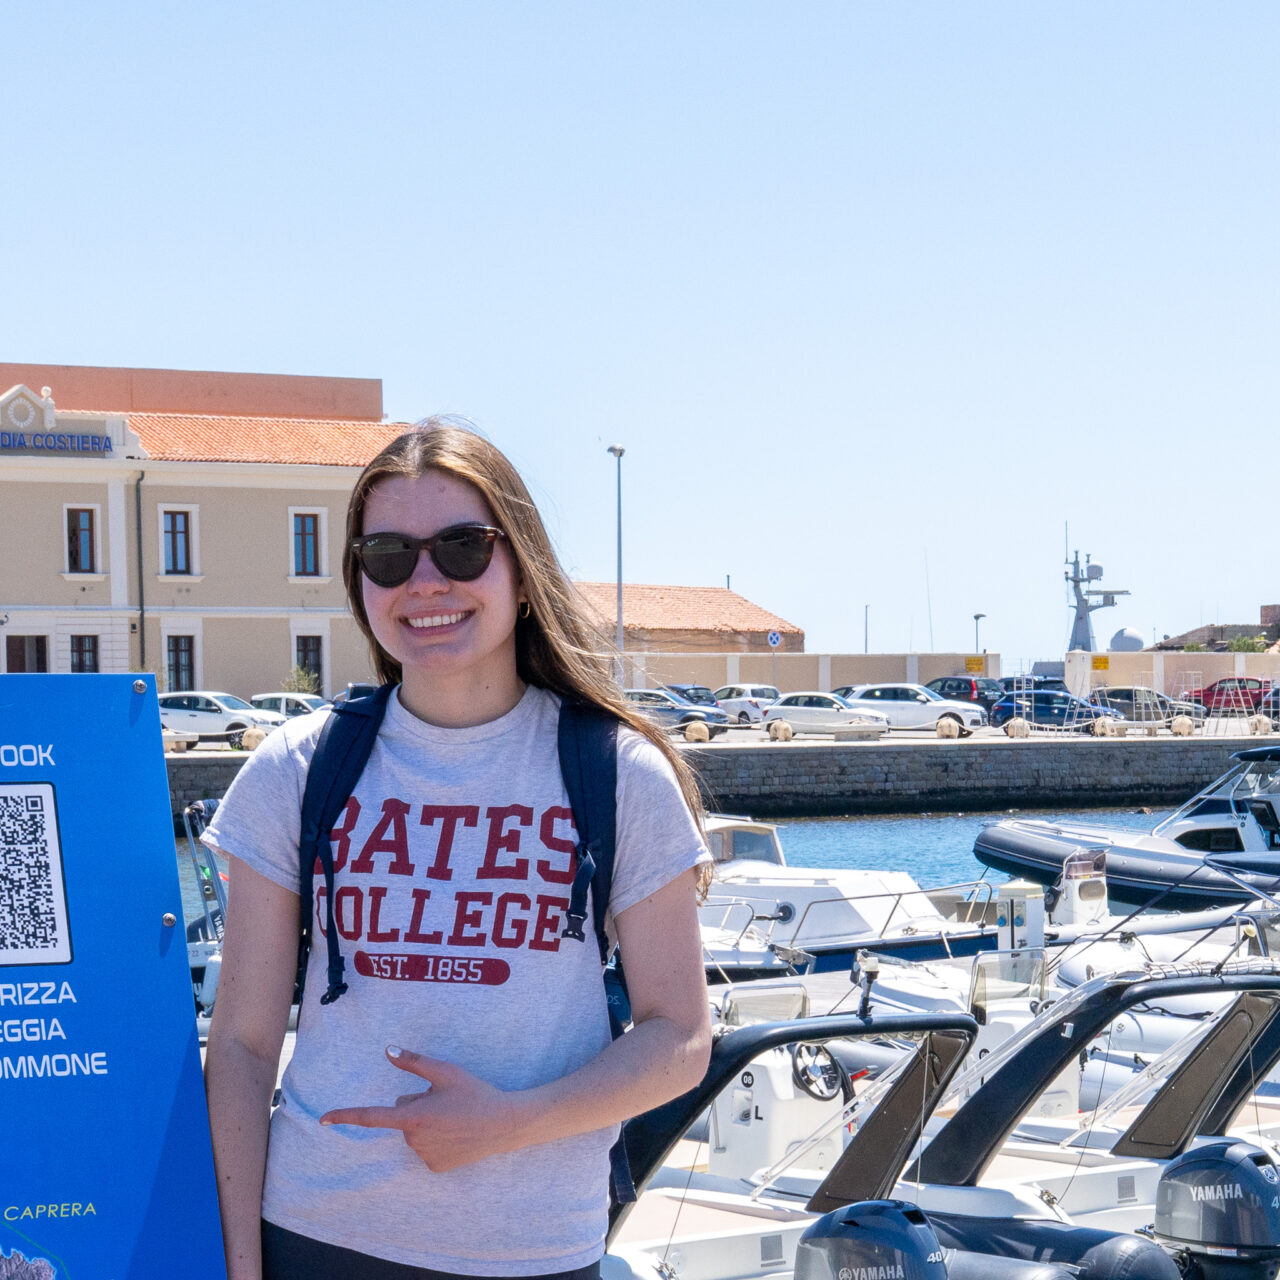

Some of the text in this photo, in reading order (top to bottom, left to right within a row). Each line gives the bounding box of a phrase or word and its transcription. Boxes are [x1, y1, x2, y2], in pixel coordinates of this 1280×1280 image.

[32, 433, 113, 452] COSTIERA
[368, 956, 483, 981] EST. 1855
[755, 1105, 764, 1120] L
[1189, 1183, 1243, 1202] YAMAHA
[1271, 1195, 1280, 1209] 4
[3, 1202, 97, 1221] CAPRERA
[926, 1251, 943, 1265] 40
